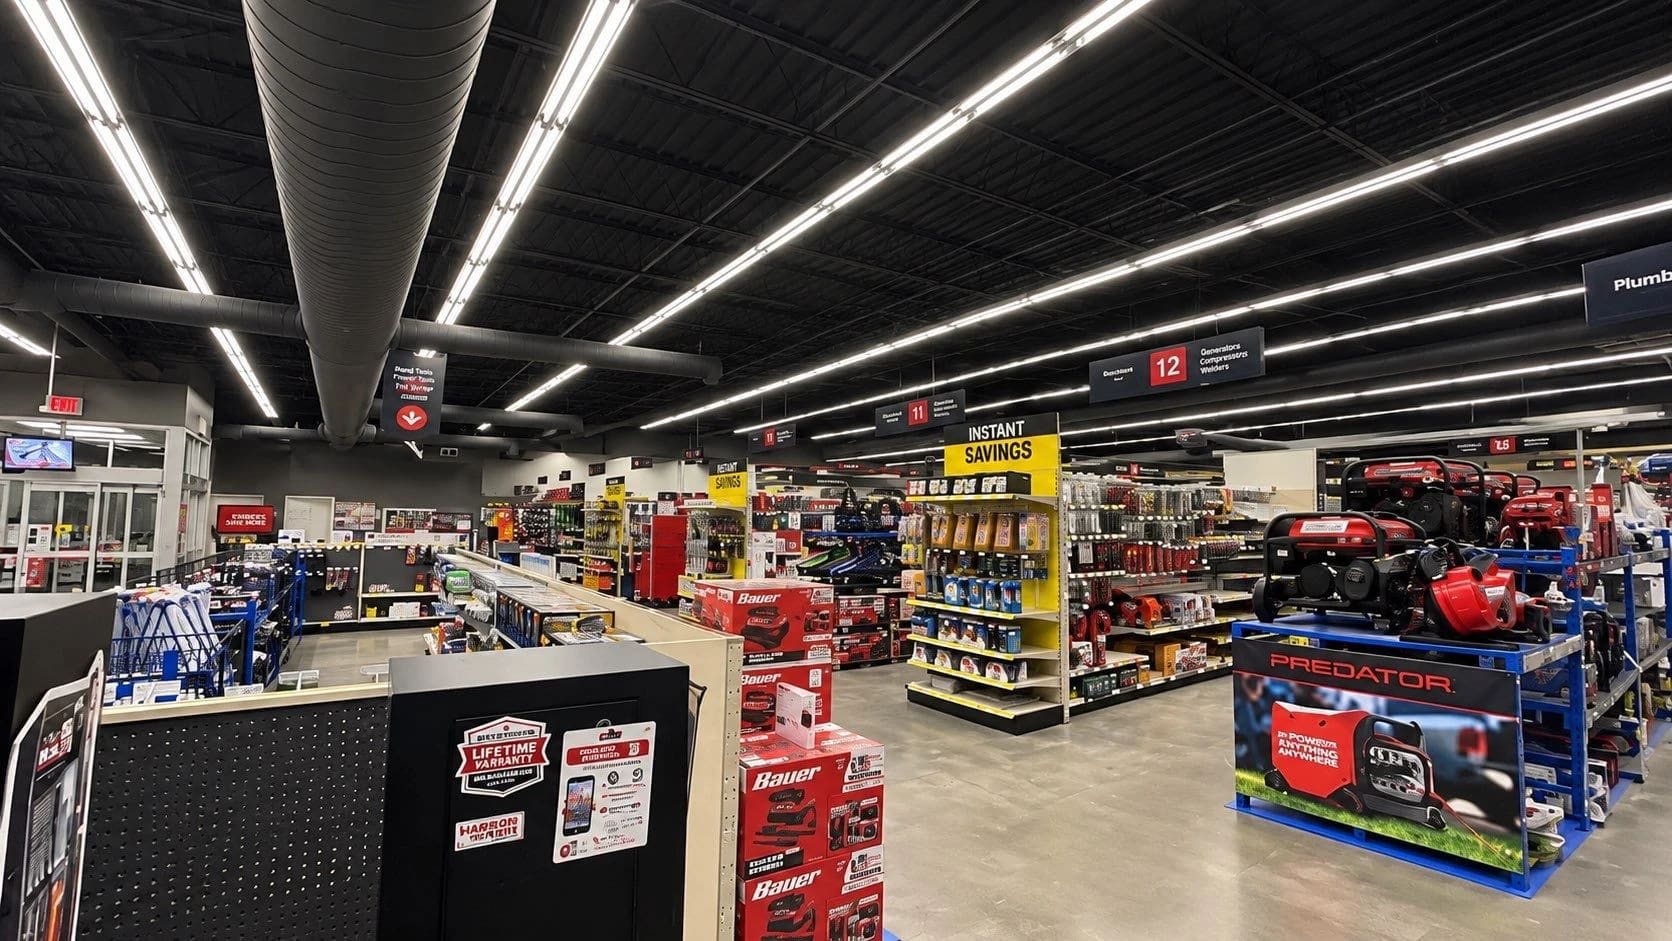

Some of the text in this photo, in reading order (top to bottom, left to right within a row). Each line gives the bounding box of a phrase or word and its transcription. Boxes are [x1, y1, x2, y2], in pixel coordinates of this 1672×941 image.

[1614, 269, 1672, 291] Plumb
[1156, 355, 1181, 378] 12
[912, 405, 923, 420] 11
[968, 420, 1025, 442] INSTANT
[965, 440, 1033, 464] SAVINGS
[736, 592, 782, 605] Bauer
[1270, 653, 1454, 694] PREDATOR
[472, 741, 537, 760] LIFETIME
[752, 765, 822, 791] Bauer
[751, 869, 822, 902] Bauer
